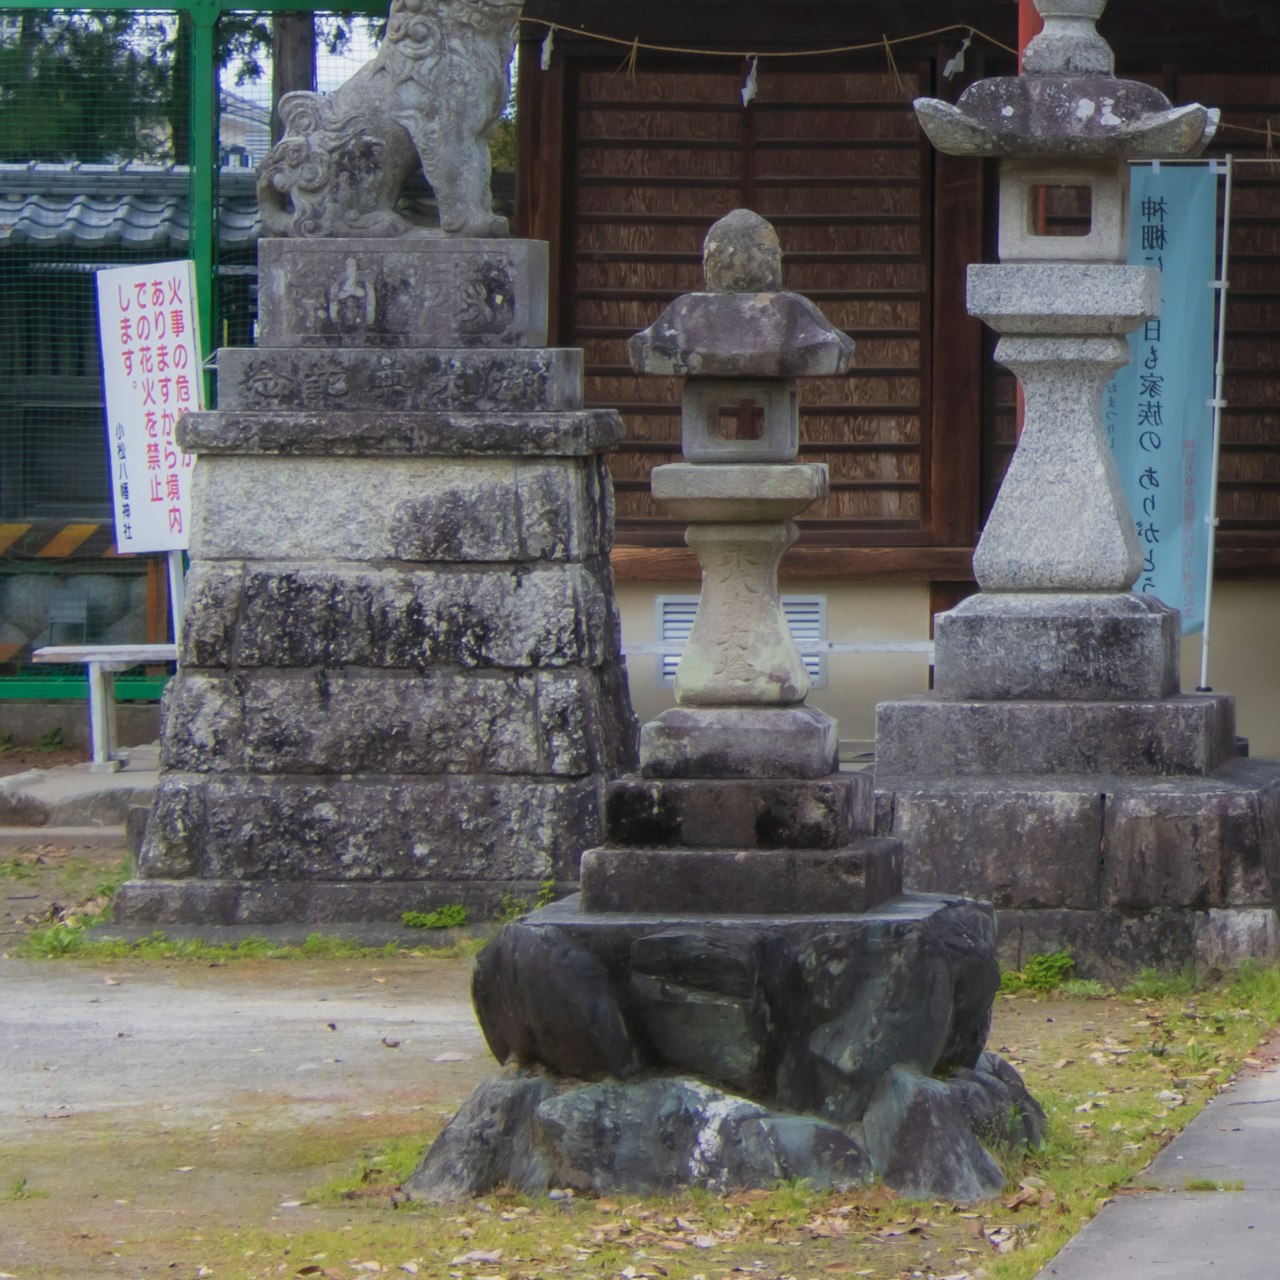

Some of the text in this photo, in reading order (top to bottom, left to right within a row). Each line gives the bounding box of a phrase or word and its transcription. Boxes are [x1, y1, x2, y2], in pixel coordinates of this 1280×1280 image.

[118, 284, 137, 390] します。
[134, 282, 164, 502] での花火を禁止
[151, 279, 183, 535] ありますから境内
[168, 276, 192, 468] 火事の危
[115, 422, 133, 540] 小松八幡神社
